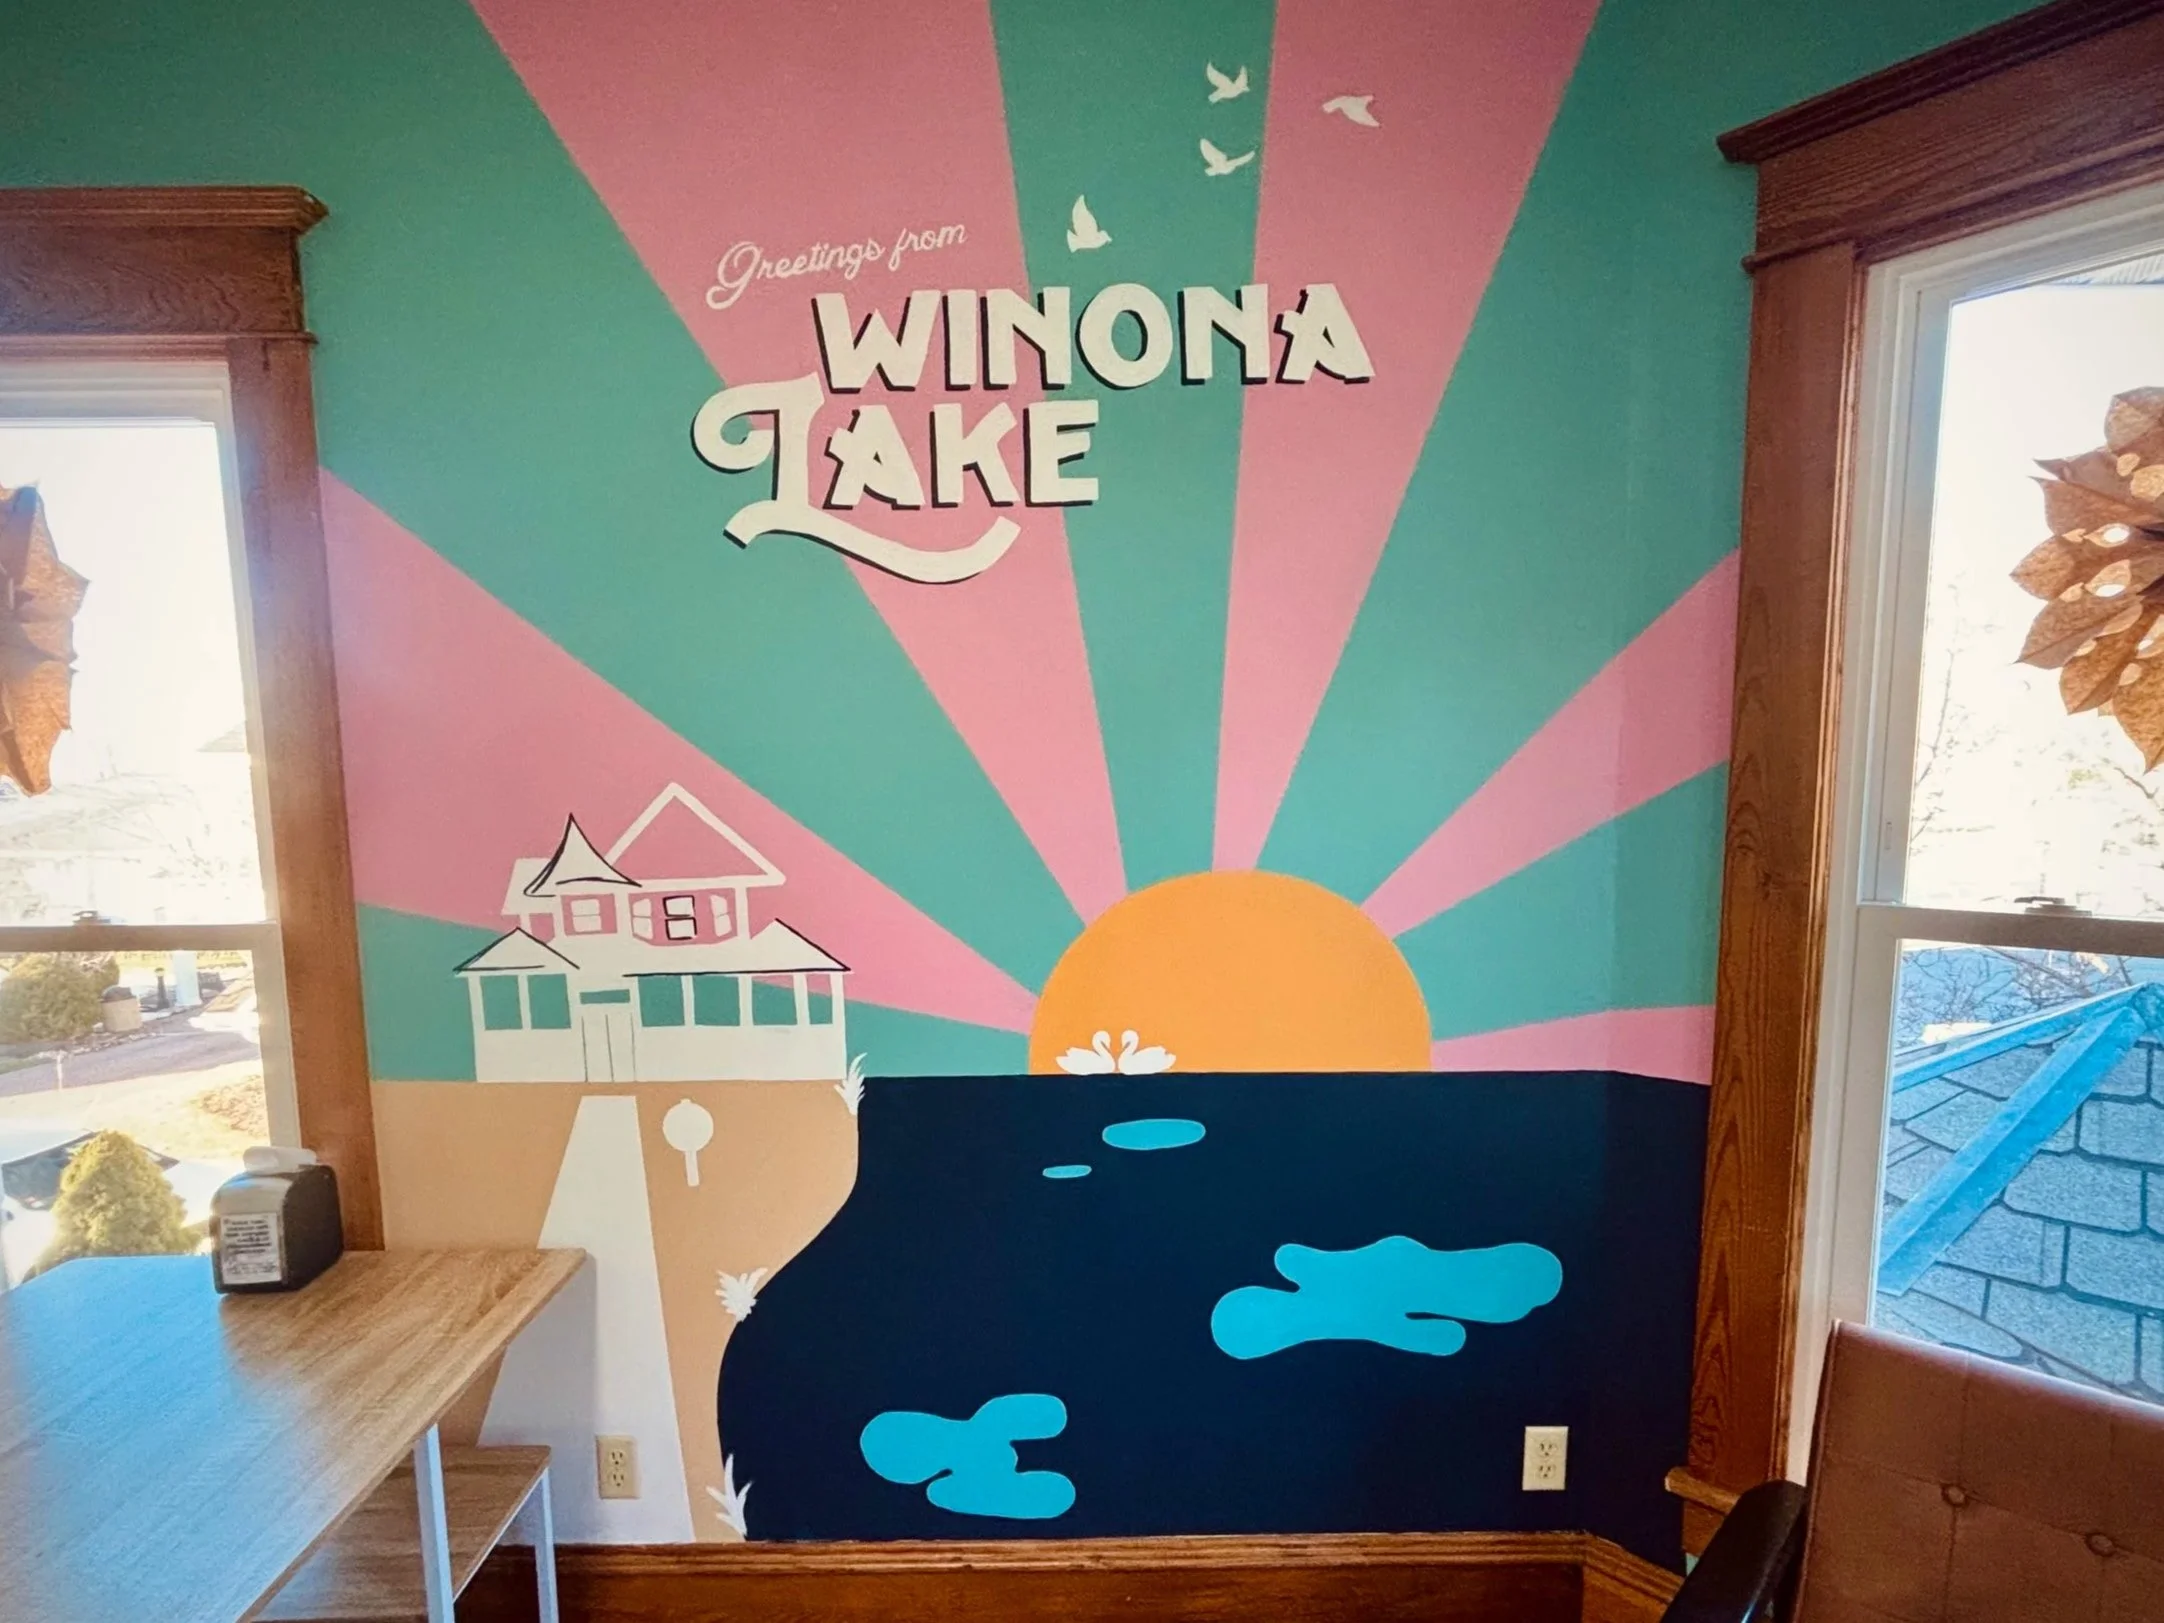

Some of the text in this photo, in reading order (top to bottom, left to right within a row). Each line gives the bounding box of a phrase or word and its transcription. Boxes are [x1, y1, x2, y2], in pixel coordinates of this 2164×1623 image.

[706, 222, 967, 310] Greetings from
[812, 283, 1376, 391] WINONA
[691, 372, 1099, 584] LAKE
